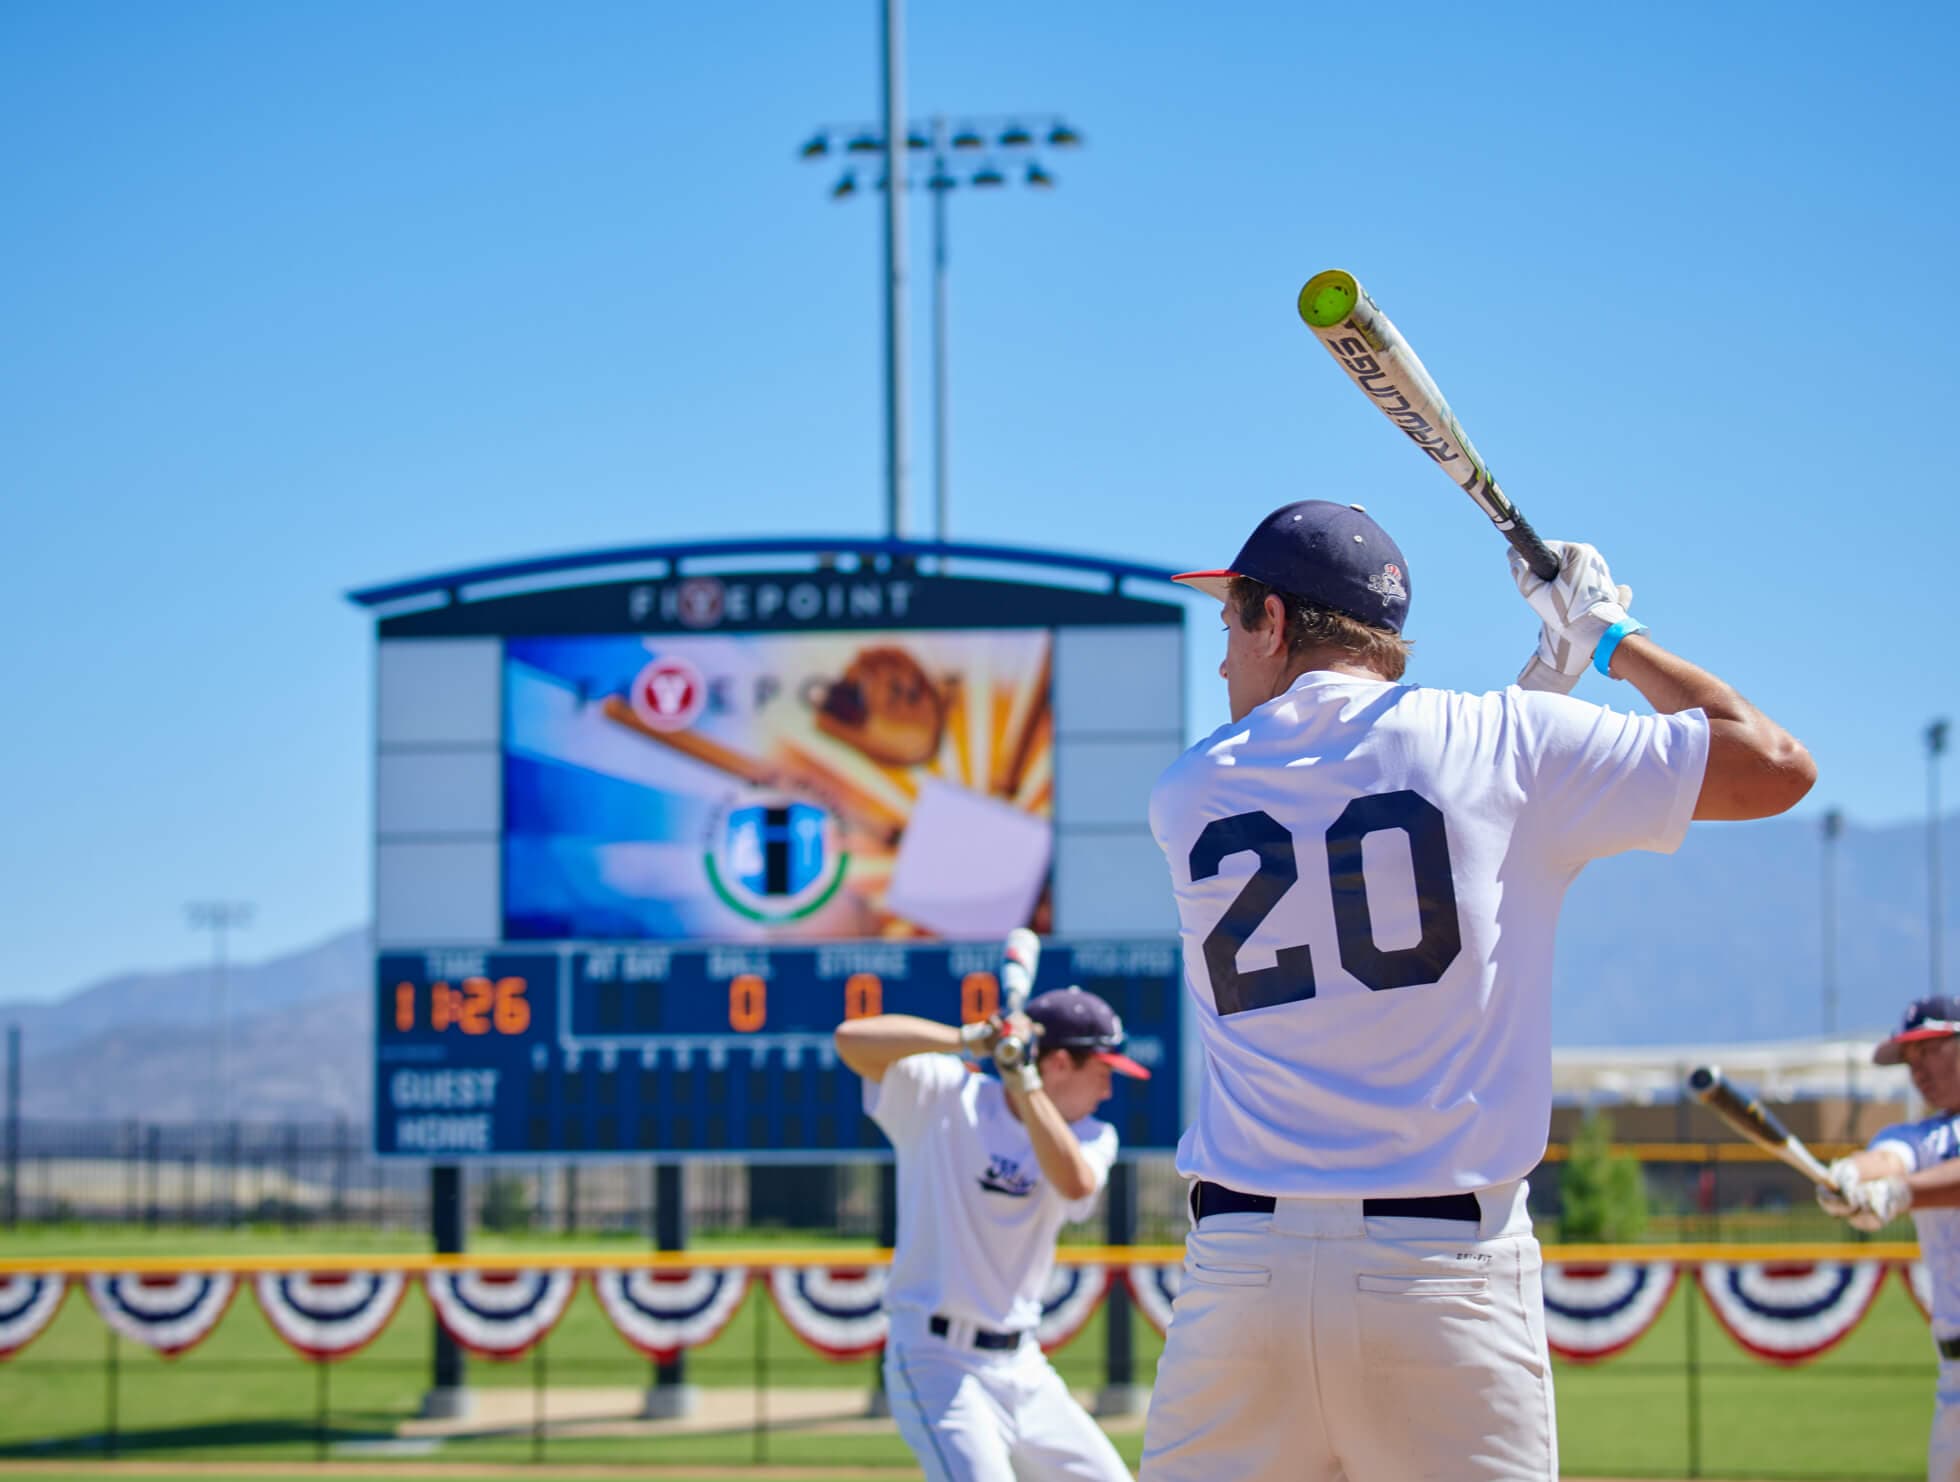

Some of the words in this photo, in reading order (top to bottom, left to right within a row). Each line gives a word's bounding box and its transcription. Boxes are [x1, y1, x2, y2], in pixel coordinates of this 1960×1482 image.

[1188, 789, 1462, 1017] 20
[729, 974, 767, 1032] 0
[845, 973, 883, 1018] 0
[961, 972, 999, 1024] 0
[392, 1070, 497, 1108] GUEST
